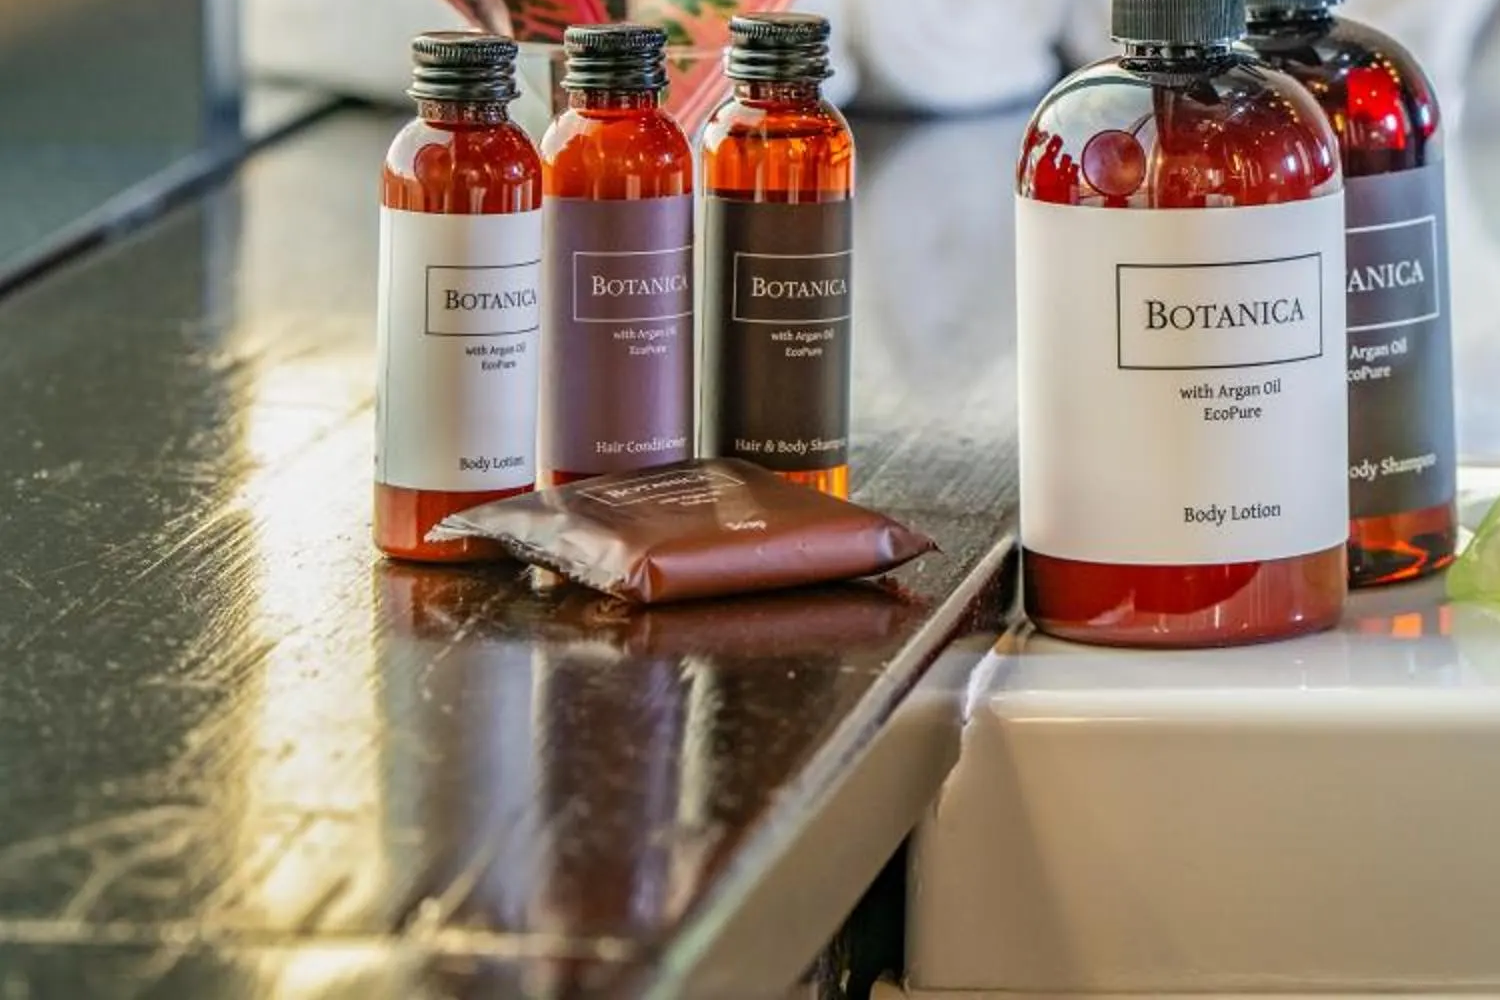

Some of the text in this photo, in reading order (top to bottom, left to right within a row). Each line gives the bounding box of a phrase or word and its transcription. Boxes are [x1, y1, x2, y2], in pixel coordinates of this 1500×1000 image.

[591, 274, 688, 297] BOTANICA
[751, 276, 848, 298] BOTANICA
[1347, 258, 1425, 293] ANICA
[443, 288, 537, 311] BOTANICA
[1144, 297, 1305, 331] BOTANICA
[1349, 337, 1407, 361] Argan Oil
[1347, 365, 1391, 382] coPure
[1179, 378, 1281, 401] with Argan Oil
[1203, 404, 1263, 421] EcoPure
[595, 440, 624, 454] Hair
[735, 437, 761, 452] Hair
[777, 438, 809, 456] Body
[809, 436, 847, 452] Sham
[459, 454, 525, 474] Body Lotion
[1349, 458, 1379, 482] ody
[1183, 501, 1282, 527] Body Lotion
